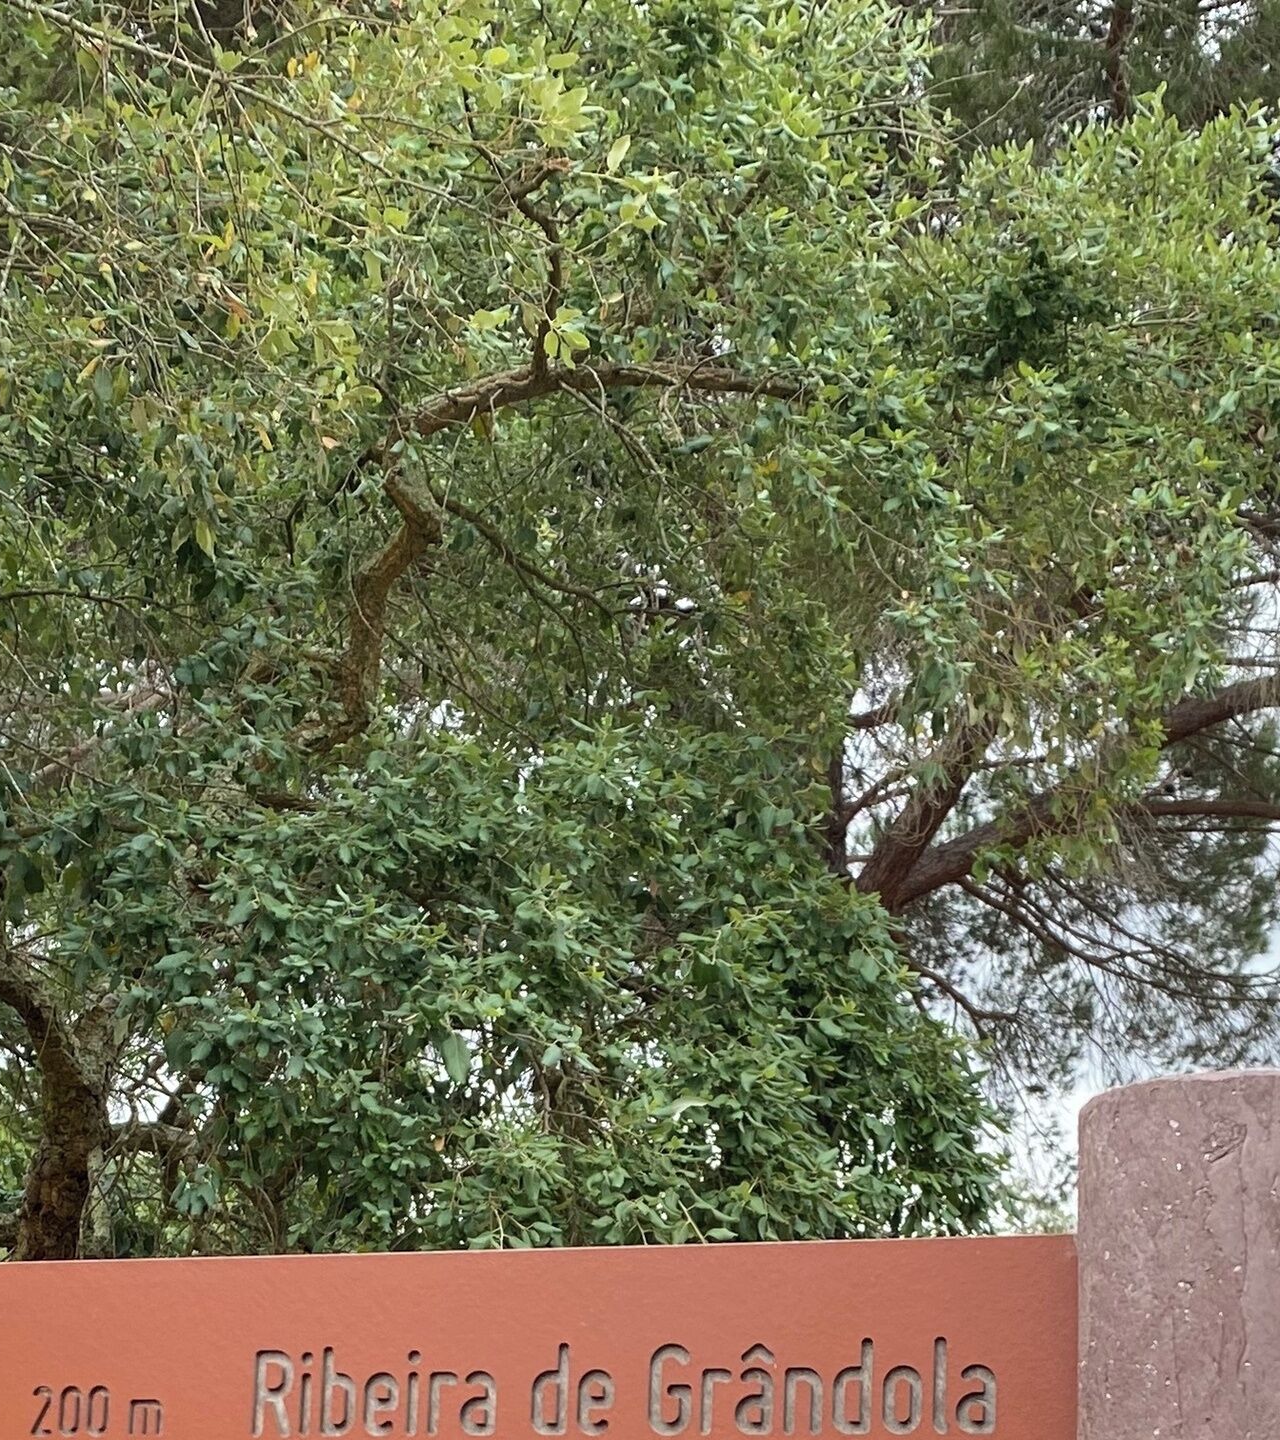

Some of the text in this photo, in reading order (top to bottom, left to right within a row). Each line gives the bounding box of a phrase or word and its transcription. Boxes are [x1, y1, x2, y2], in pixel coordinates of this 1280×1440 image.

[30, 1336, 998, 1438] 200 m Ribeira de Grândola
